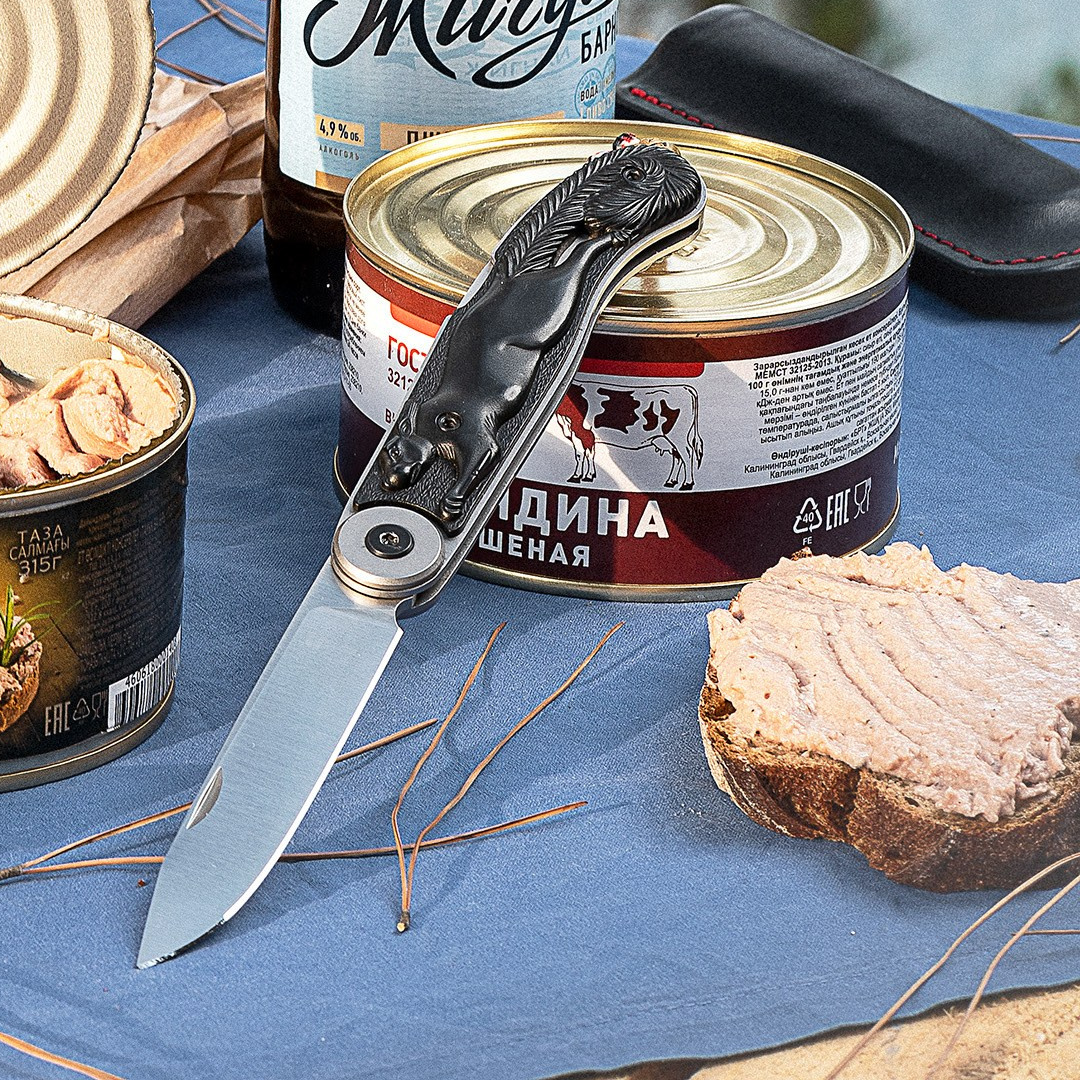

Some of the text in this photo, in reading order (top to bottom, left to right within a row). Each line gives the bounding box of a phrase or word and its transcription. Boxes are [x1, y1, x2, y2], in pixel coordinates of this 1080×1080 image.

[580, 84, 599, 102] ВОДА
[319, 118, 336, 137] 4,9
[753, 341, 847, 372] Зарарсыздандырылған
[755, 366, 787, 380] МЕМСТ
[789, 356, 832, 374] 32125-2013.
[748, 380, 763, 390] 100
[765, 379, 769, 388] г
[759, 388, 776, 398] 15,0
[758, 415, 819, 436] температурада,
[764, 412, 793, 426] мерзімі
[760, 431, 792, 445] ысытып
[744, 456, 796, 475] Калининград
[769, 459, 818, 480] Калининград
[802, 512, 814, 523] 40
[17, 524, 63, 545] ТАЗА
[802, 536, 813, 546] FE
